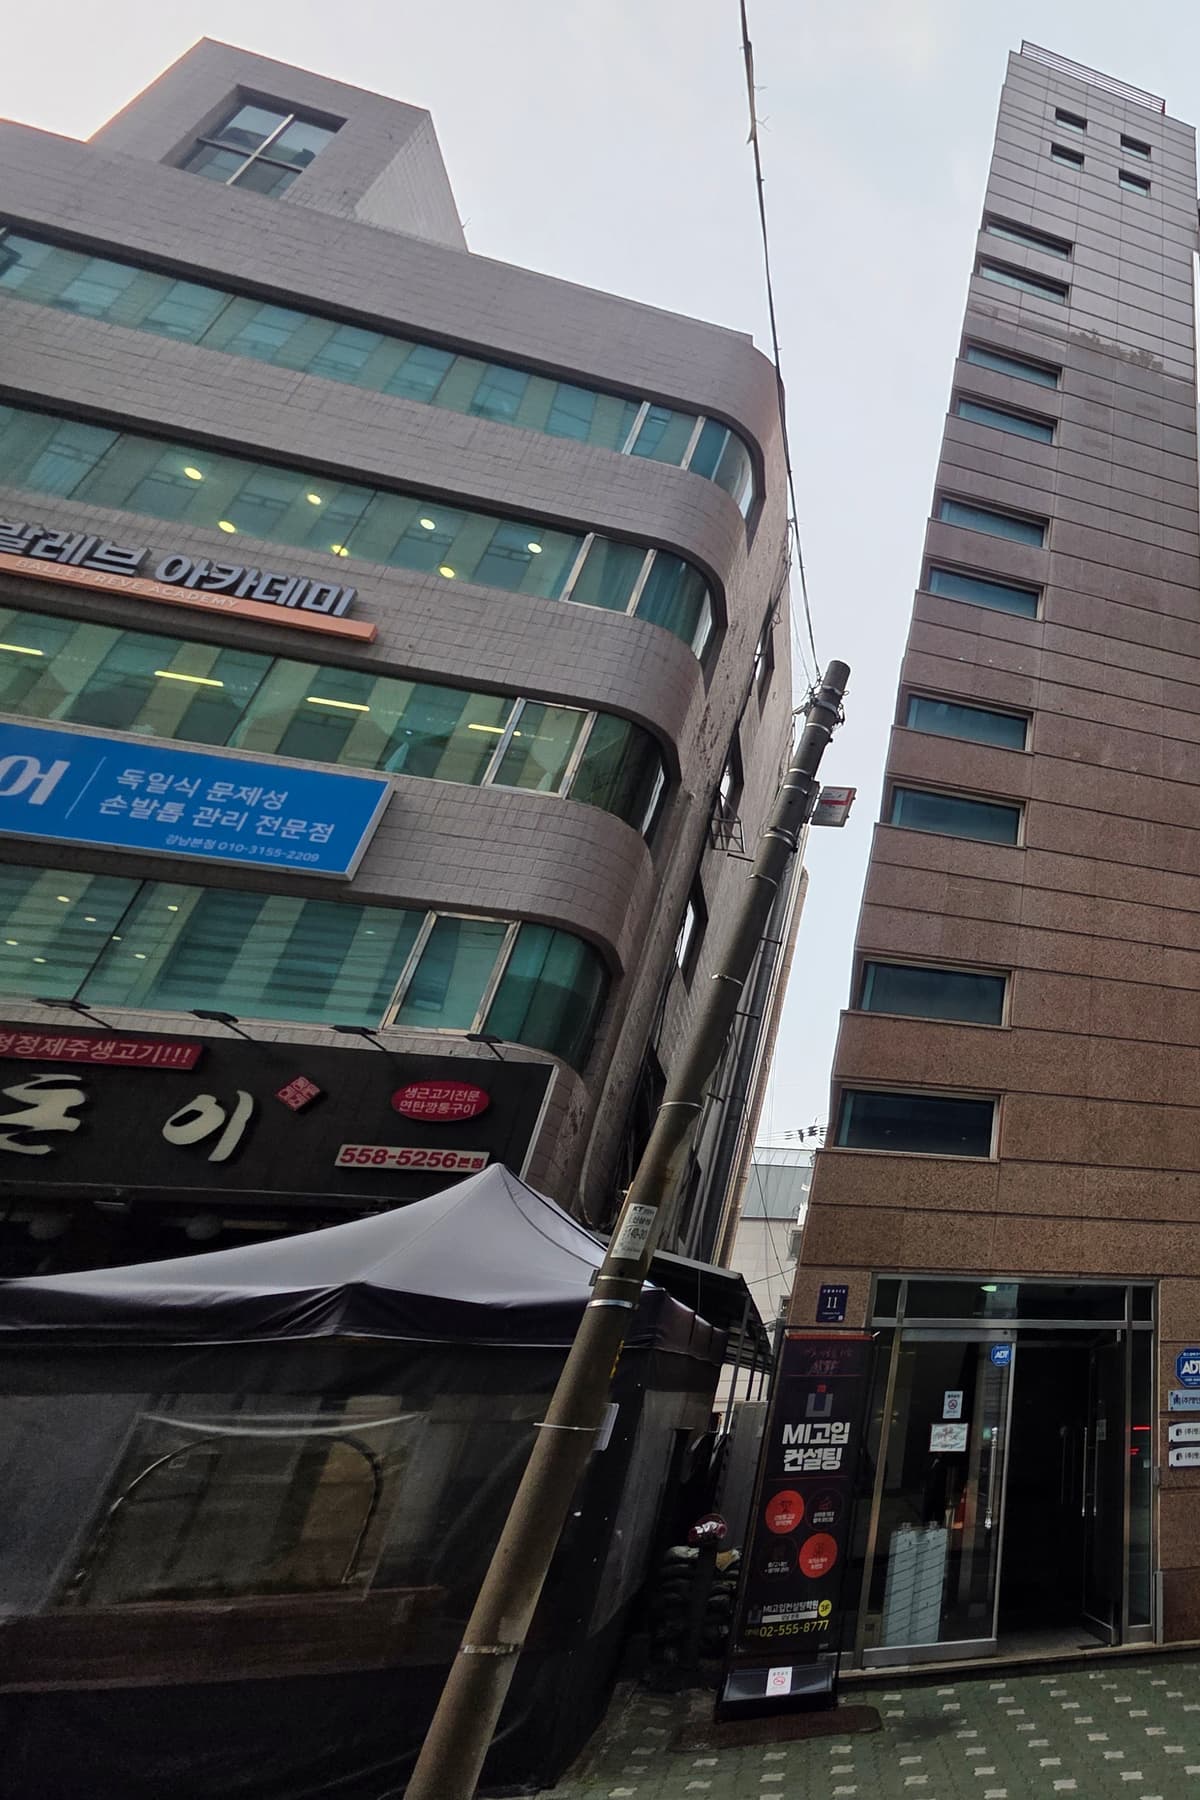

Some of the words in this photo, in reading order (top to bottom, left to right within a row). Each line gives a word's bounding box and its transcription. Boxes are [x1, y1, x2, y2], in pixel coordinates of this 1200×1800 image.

[149, 583, 239, 608] ACADEMY
[156, 553, 358, 617] 아카데미
[116, 768, 202, 799] 독일식
[206, 781, 289, 811] 문제성
[99, 794, 186, 823] 손발톱
[192, 806, 249, 832] 관리
[255, 814, 335, 844] 전문점
[781, 1421, 851, 1445] MI고입
[783, 1447, 843, 1472] 컨설팅
[760, 1620, 830, 1638] 02-555-8777
